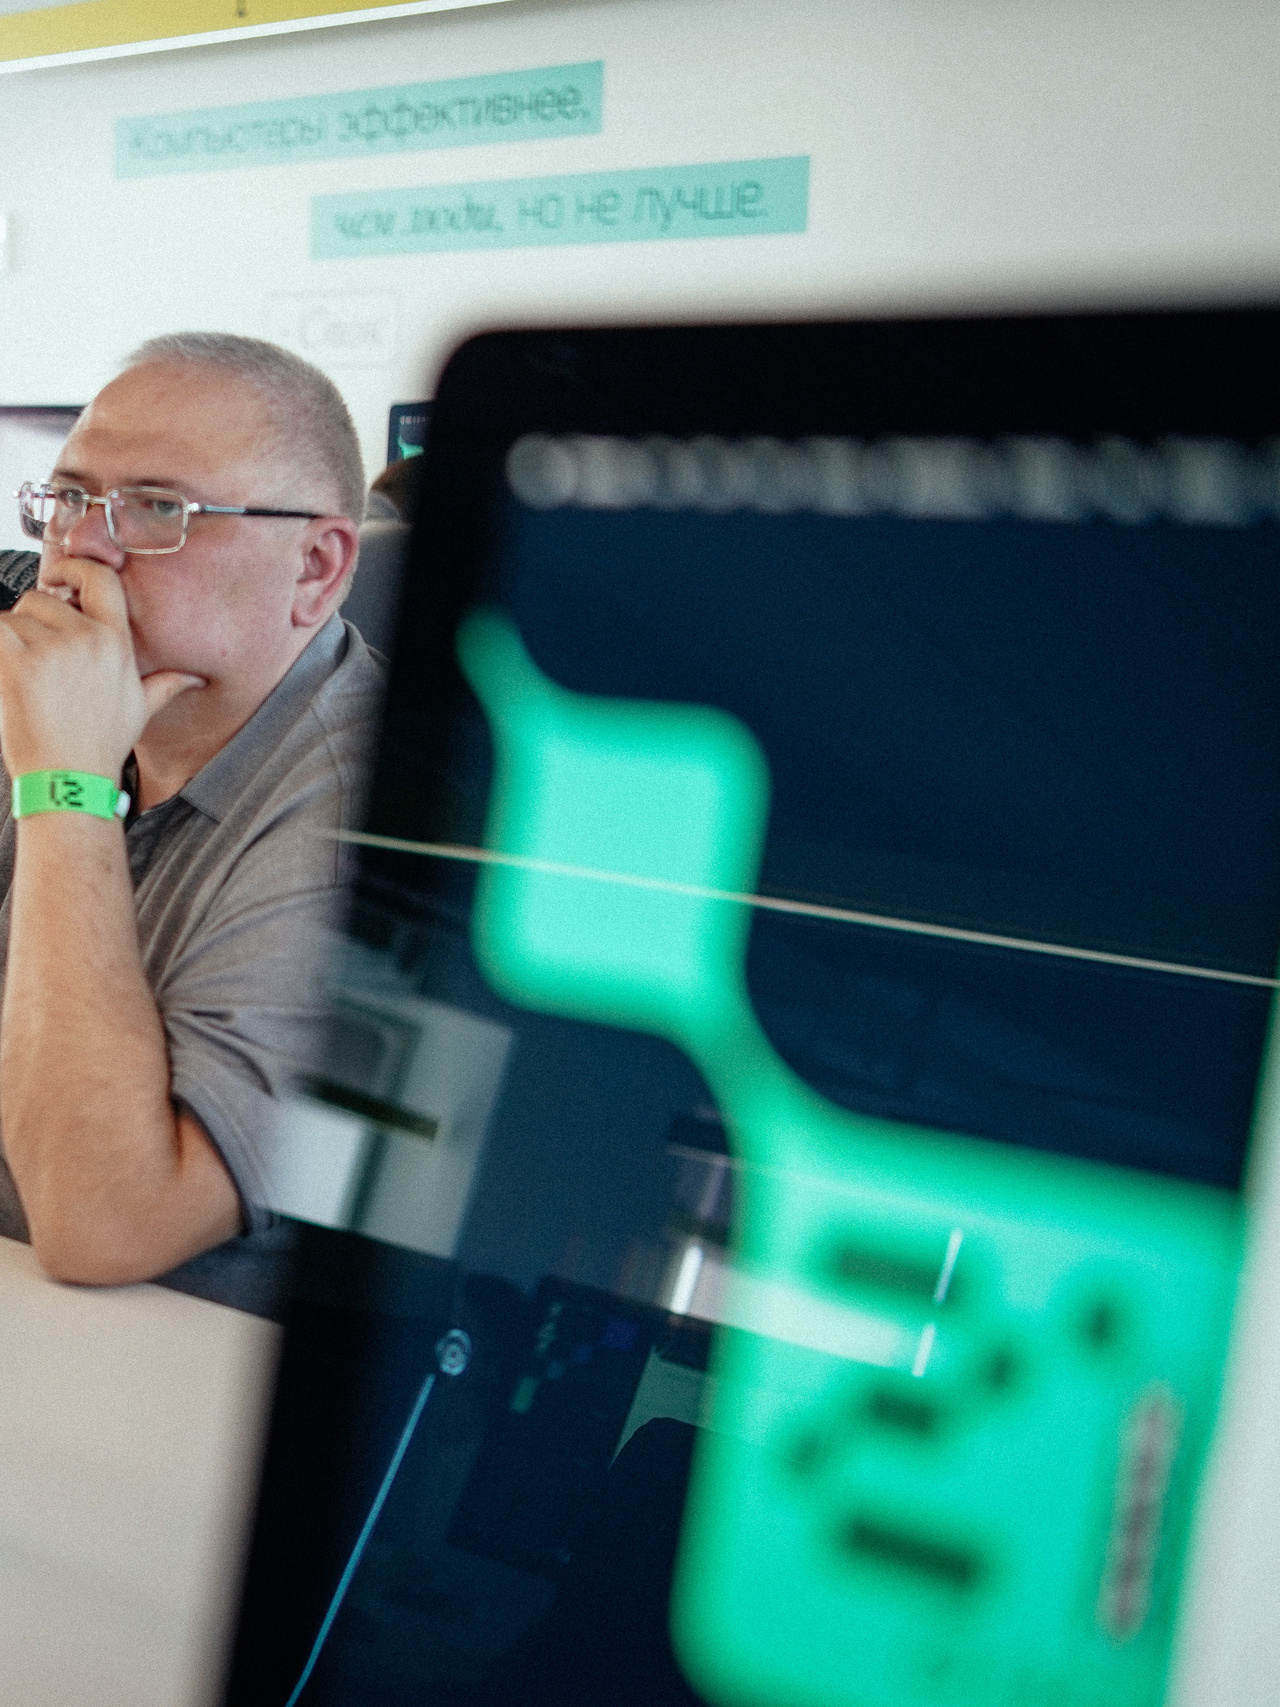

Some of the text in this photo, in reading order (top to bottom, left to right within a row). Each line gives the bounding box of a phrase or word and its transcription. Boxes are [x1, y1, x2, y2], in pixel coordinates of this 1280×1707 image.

[337, 84, 590, 145] эффективнее,
[333, 207, 396, 240] чем
[518, 192, 564, 231] но
[574, 188, 622, 227] не
[631, 179, 770, 232] лучше.
